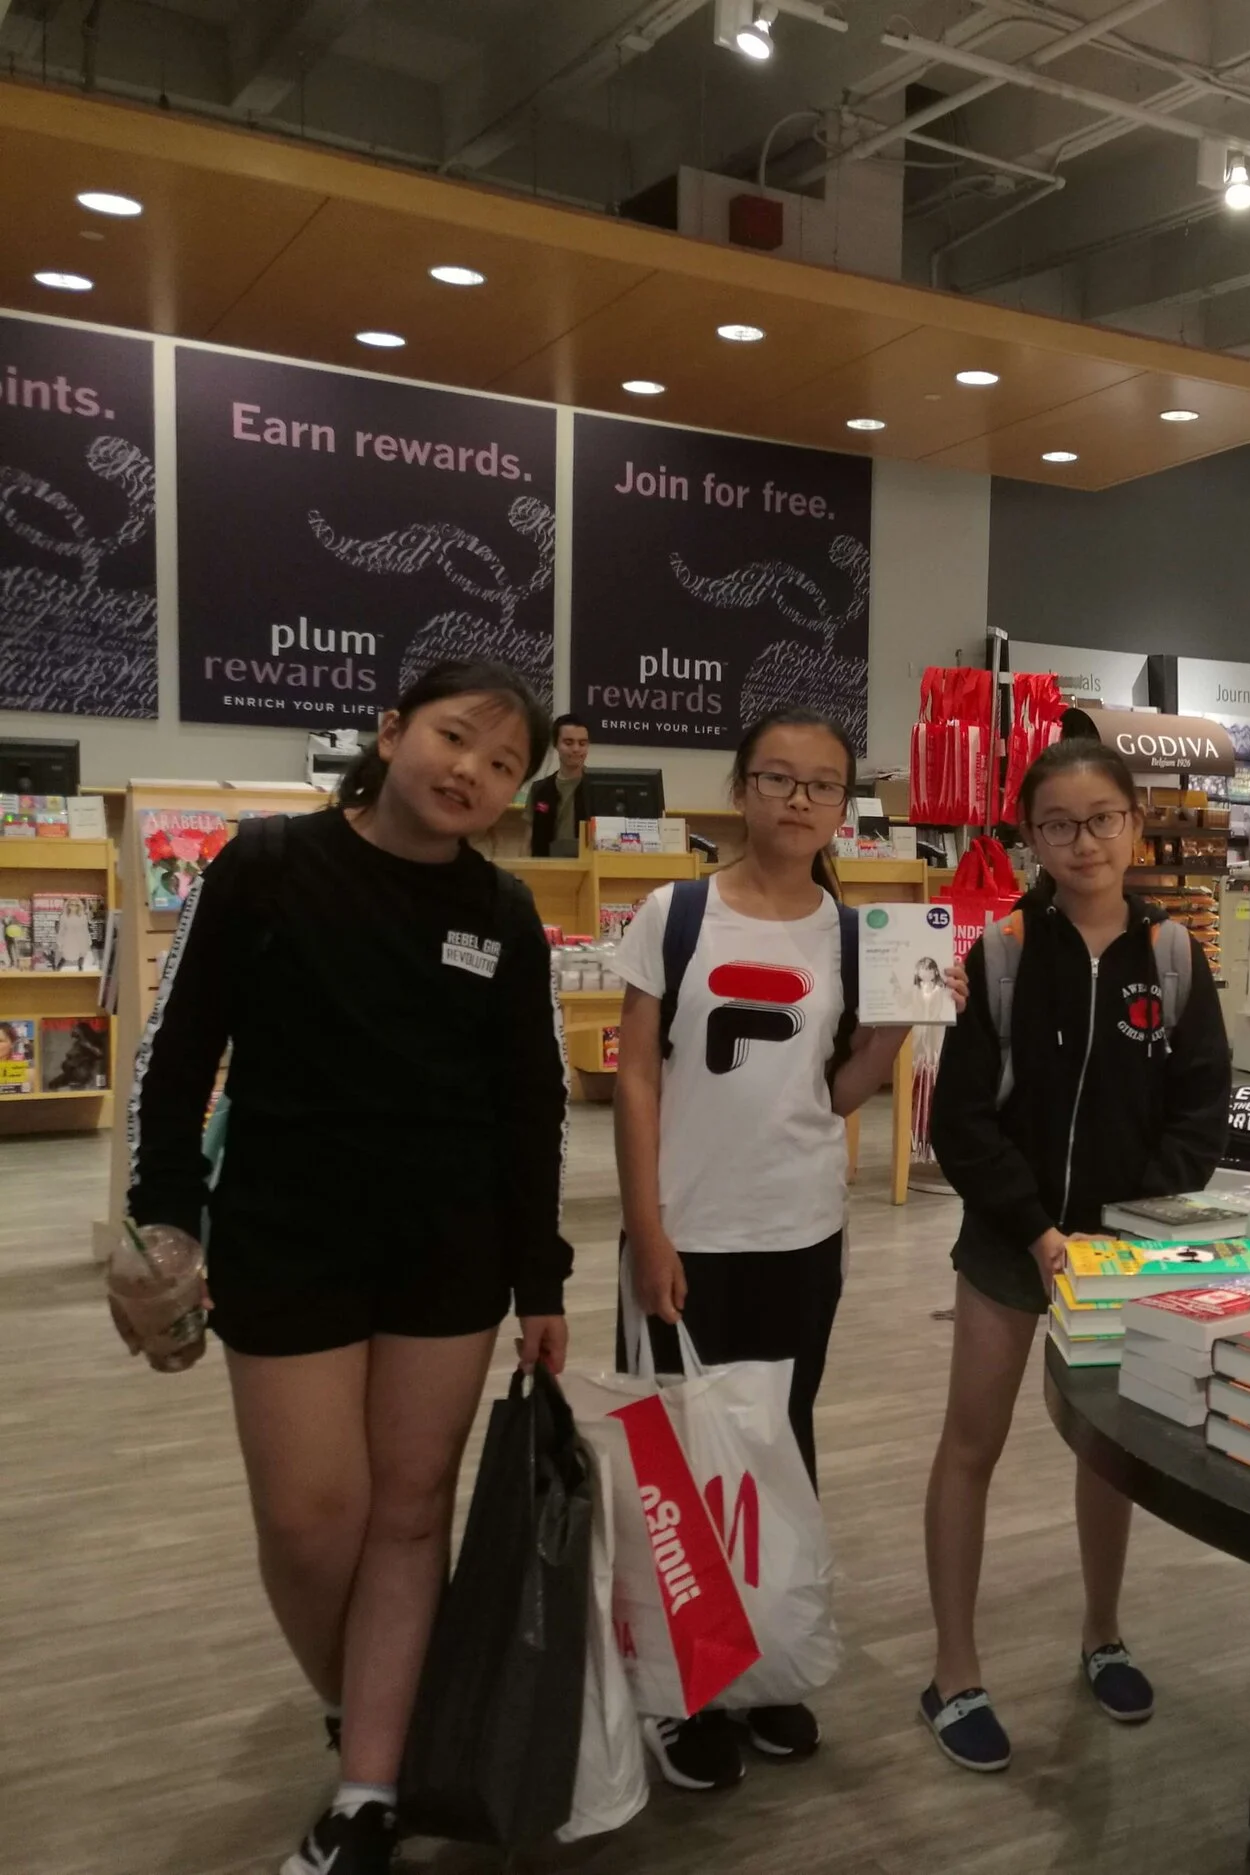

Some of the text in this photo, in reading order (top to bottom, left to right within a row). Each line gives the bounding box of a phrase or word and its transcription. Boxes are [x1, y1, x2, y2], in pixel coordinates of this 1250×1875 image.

[0, 367, 115, 418] ints.
[233, 402, 533, 482] Earn rewards.
[615, 461, 836, 520] Join for free.
[271, 616, 377, 656] plum
[204, 655, 377, 692] rewards
[640, 647, 722, 684] plum
[223, 695, 376, 715] ENRICH YOUR LIFE
[587, 683, 722, 714] rewards
[601, 719, 721, 735] ENRICH YOUR LIFE
[1116, 733, 1220, 759] GODIVA
[1151, 757, 1191, 768] Belgium 1926
[149, 813, 226, 831] ARABELLA
[928, 912, 949, 925] $15
[447, 930, 502, 956] REBEL GIR
[446, 948, 497, 974] REVOLUTIO
[1117, 1020, 1145, 1042] GIRLS
